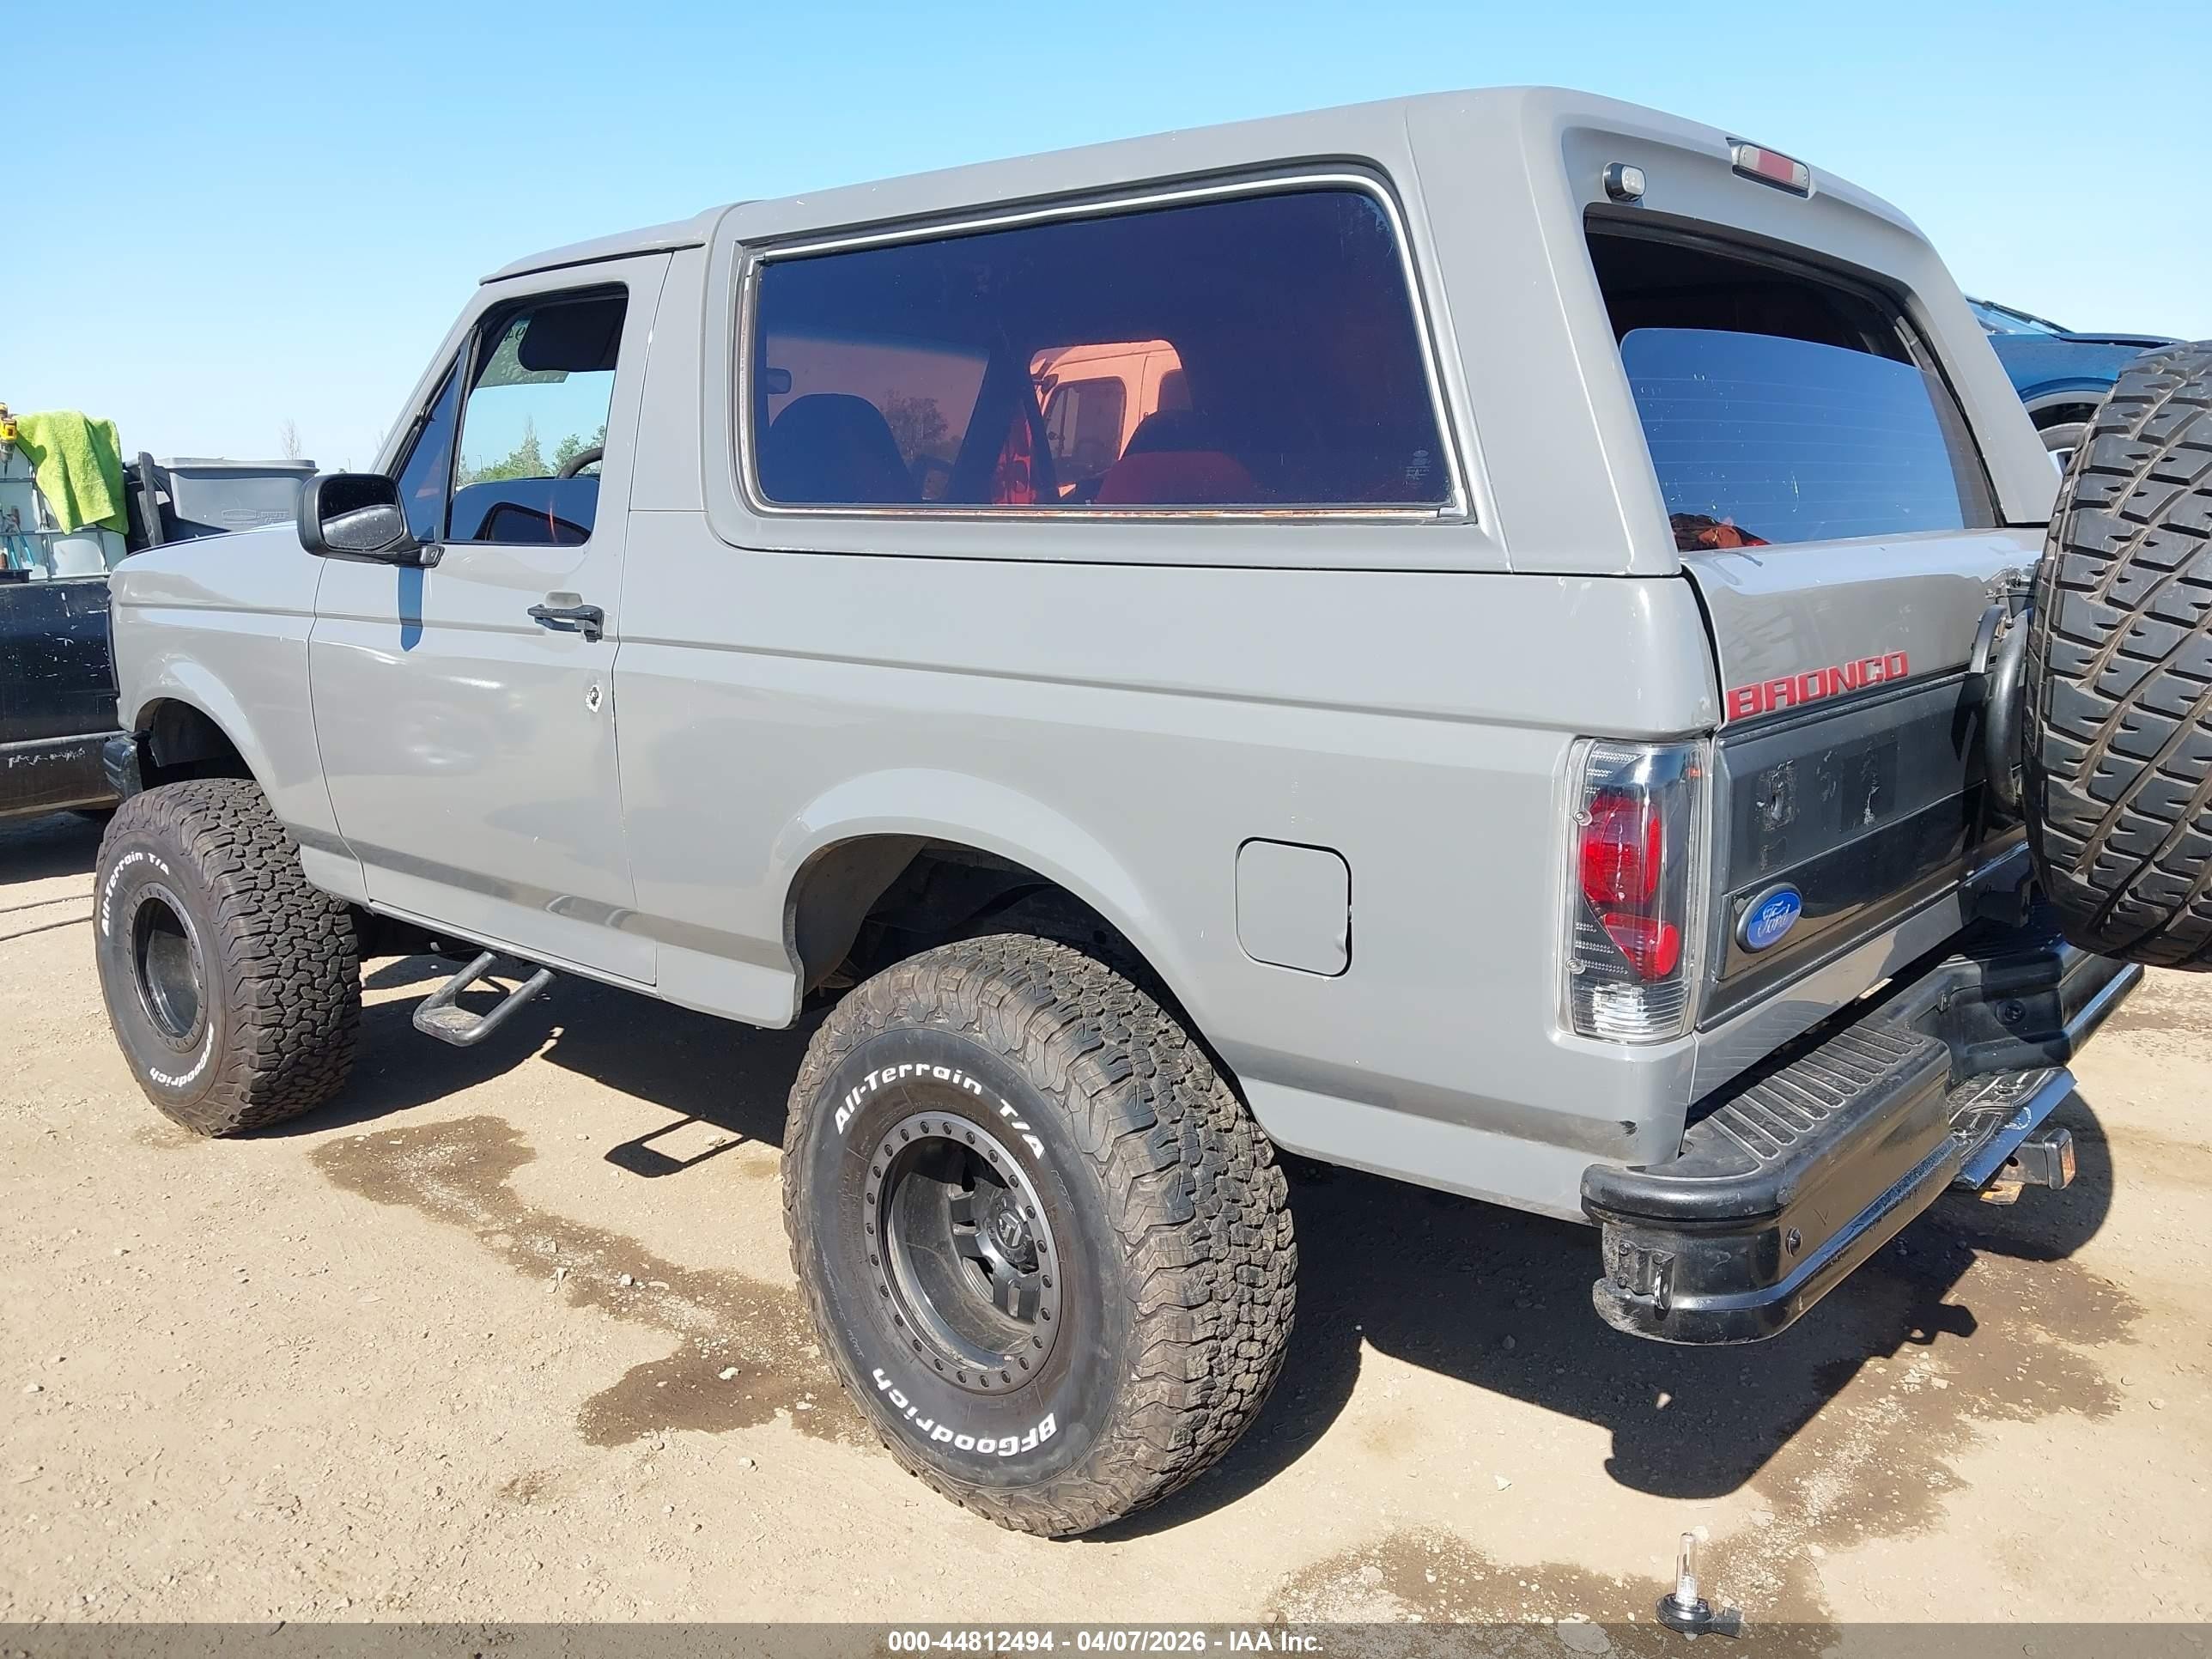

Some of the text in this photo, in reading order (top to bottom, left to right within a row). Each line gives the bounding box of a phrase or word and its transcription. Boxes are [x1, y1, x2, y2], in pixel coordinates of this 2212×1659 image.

[1726, 650, 1909, 723] BRONCO
[101, 851, 170, 937] All-Terrain T/A
[1757, 900, 1791, 938] Ford
[149, 1022, 214, 1088] BFGoodrich
[835, 1063, 1046, 1159] All-Terrain T/A
[872, 1368, 1058, 1457] BFGoodrich
